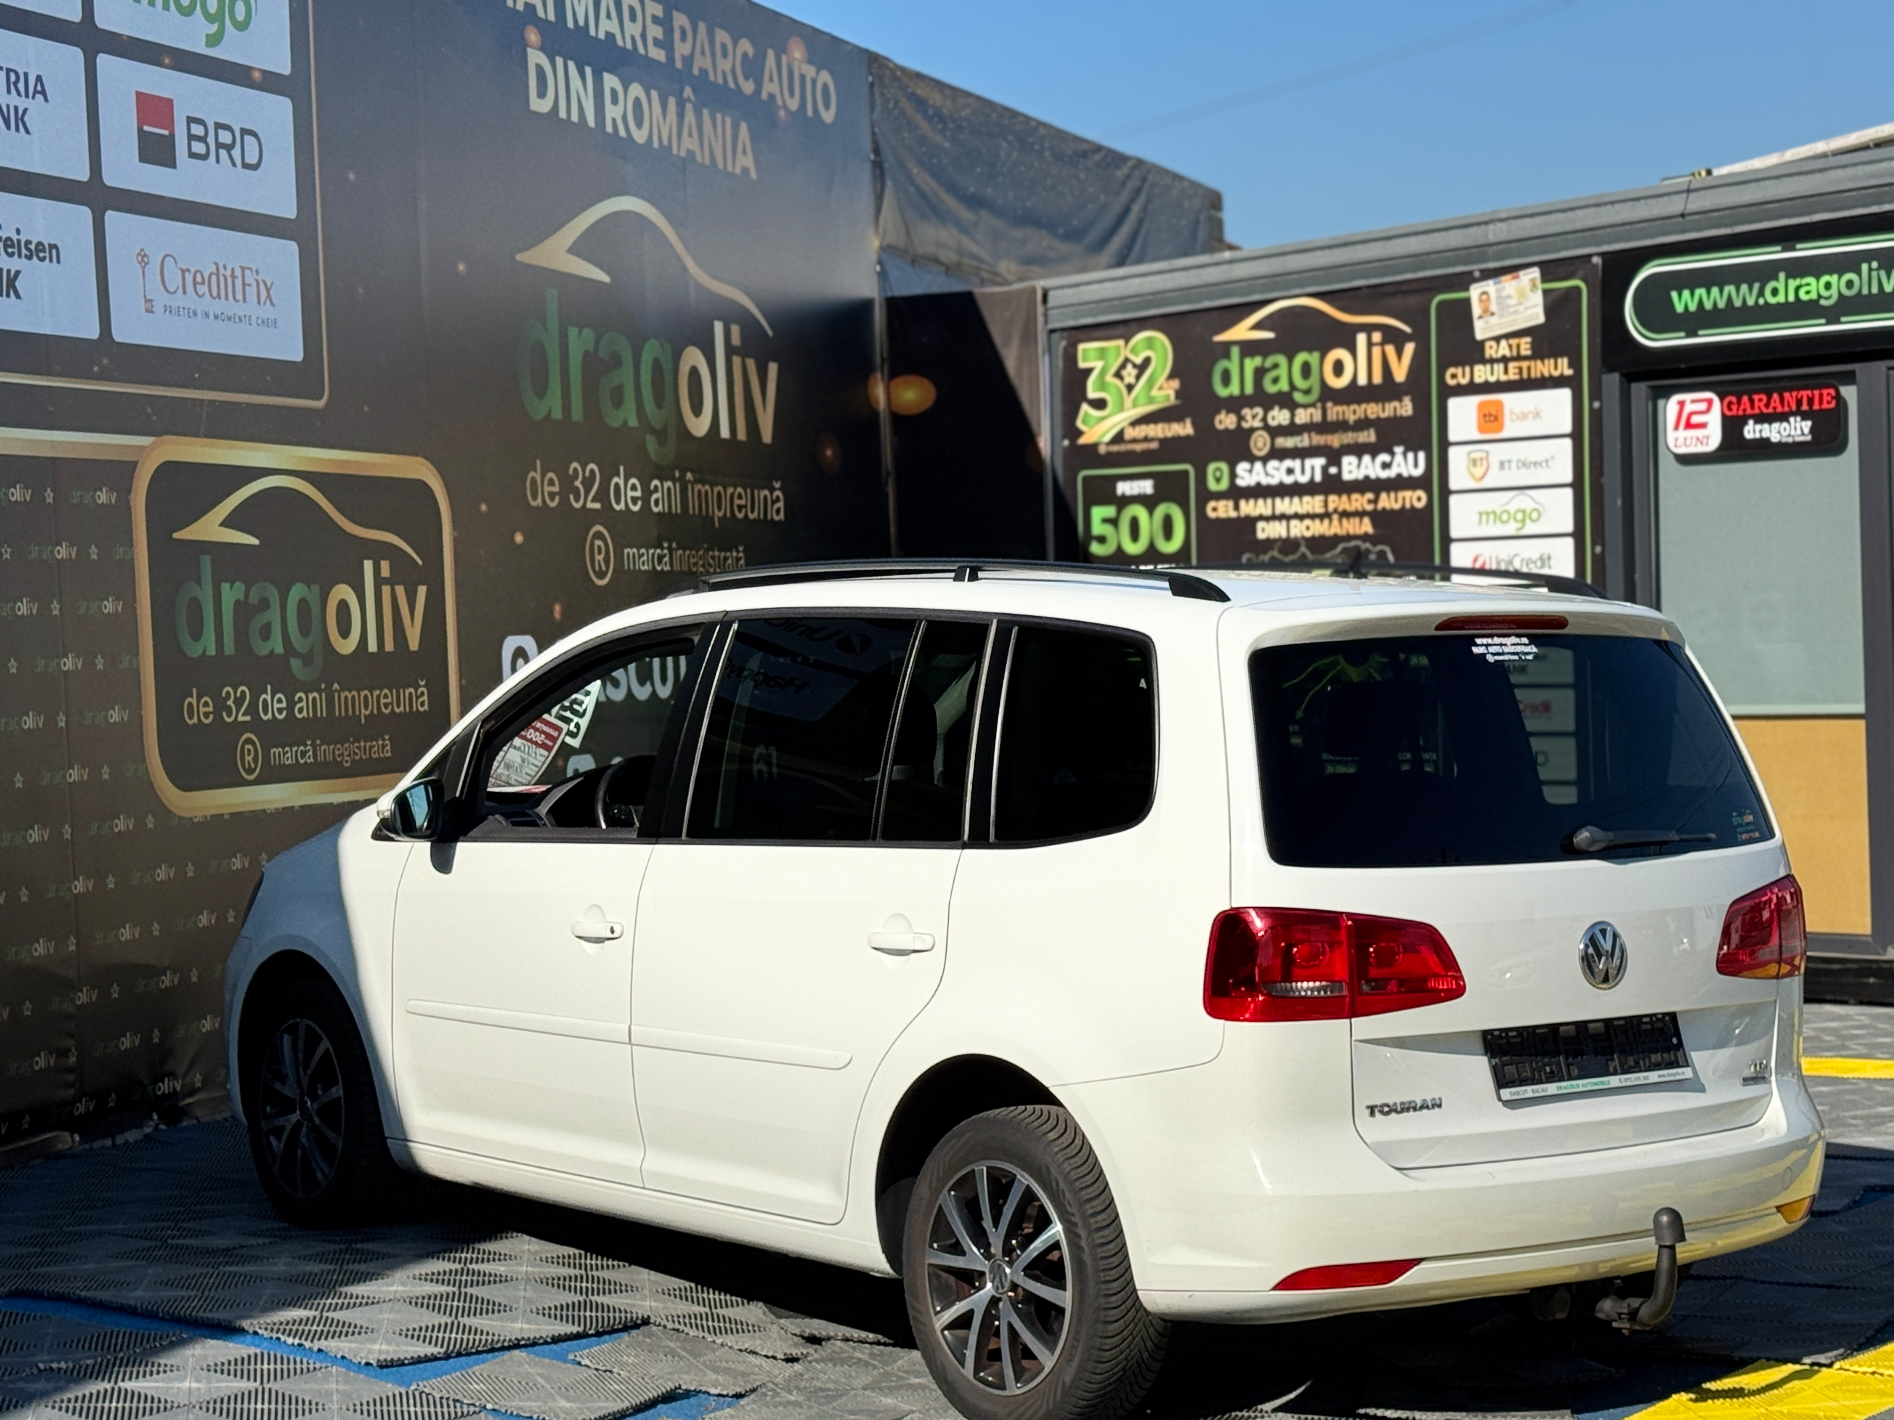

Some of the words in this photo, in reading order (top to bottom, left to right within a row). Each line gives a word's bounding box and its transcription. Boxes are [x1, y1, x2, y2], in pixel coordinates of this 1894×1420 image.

[672, 10, 755, 95] PARC
[761, 48, 837, 124] AUTO
[526, 46, 596, 128] DIN
[603, 72, 757, 180] ROMÂNIA
[186, 116, 263, 172] BRD
[159, 253, 276, 308] CreditFix
[163, 304, 198, 318] PRIETEN
[201, 310, 210, 320] IN
[213, 311, 253, 326] MOMENTE
[255, 316, 278, 329] CHEIE
[1484, 336, 1532, 359] RATE
[517, 288, 779, 466] dragoliv
[1075, 330, 1174, 434] 32
[1211, 332, 1415, 404] dragoliv
[1445, 365, 1471, 386] CU
[1473, 356, 1574, 384] BULETINUL
[1214, 409, 1238, 430] de
[1240, 406, 1264, 428] 32
[1267, 404, 1291, 426] de
[1294, 402, 1322, 425] ani
[1326, 395, 1414, 424] împreună
[1509, 406, 1542, 422] bank
[1672, 398, 1714, 431] 12
[1722, 387, 1837, 416] GARANTIE
[1674, 435, 1711, 449] LUNI
[1743, 416, 1812, 442] dragoliv
[1235, 457, 1327, 487] SASCUT
[1341, 445, 1426, 481] BACĂU
[526, 460, 560, 508] de
[568, 461, 602, 510] 32
[610, 465, 642, 512] de
[650, 471, 681, 514] ani
[687, 473, 784, 528] împreună
[1116, 479, 1155, 496] PESTE
[1205, 499, 1238, 519] CEL
[1239, 498, 1272, 518] MAI
[1275, 495, 1325, 516] MARE
[1328, 492, 1375, 512] PARC
[1377, 489, 1427, 510] AUTO
[1478, 507, 1541, 532] mogo
[1088, 501, 1186, 557] 500
[1256, 519, 1288, 540] DIN
[1290, 514, 1374, 538] ROMÂNIA
[623, 541, 671, 571] marcă
[175, 555, 427, 681] dragoliv
[184, 688, 213, 725] de
[221, 686, 251, 722] 32
[259, 684, 286, 720] de
[294, 683, 326, 718] ani
[333, 680, 429, 723] împreună
[270, 739, 313, 766] marcă
[316, 735, 391, 766] înregistrată
[1366, 1097, 1442, 1118] TOURAN
